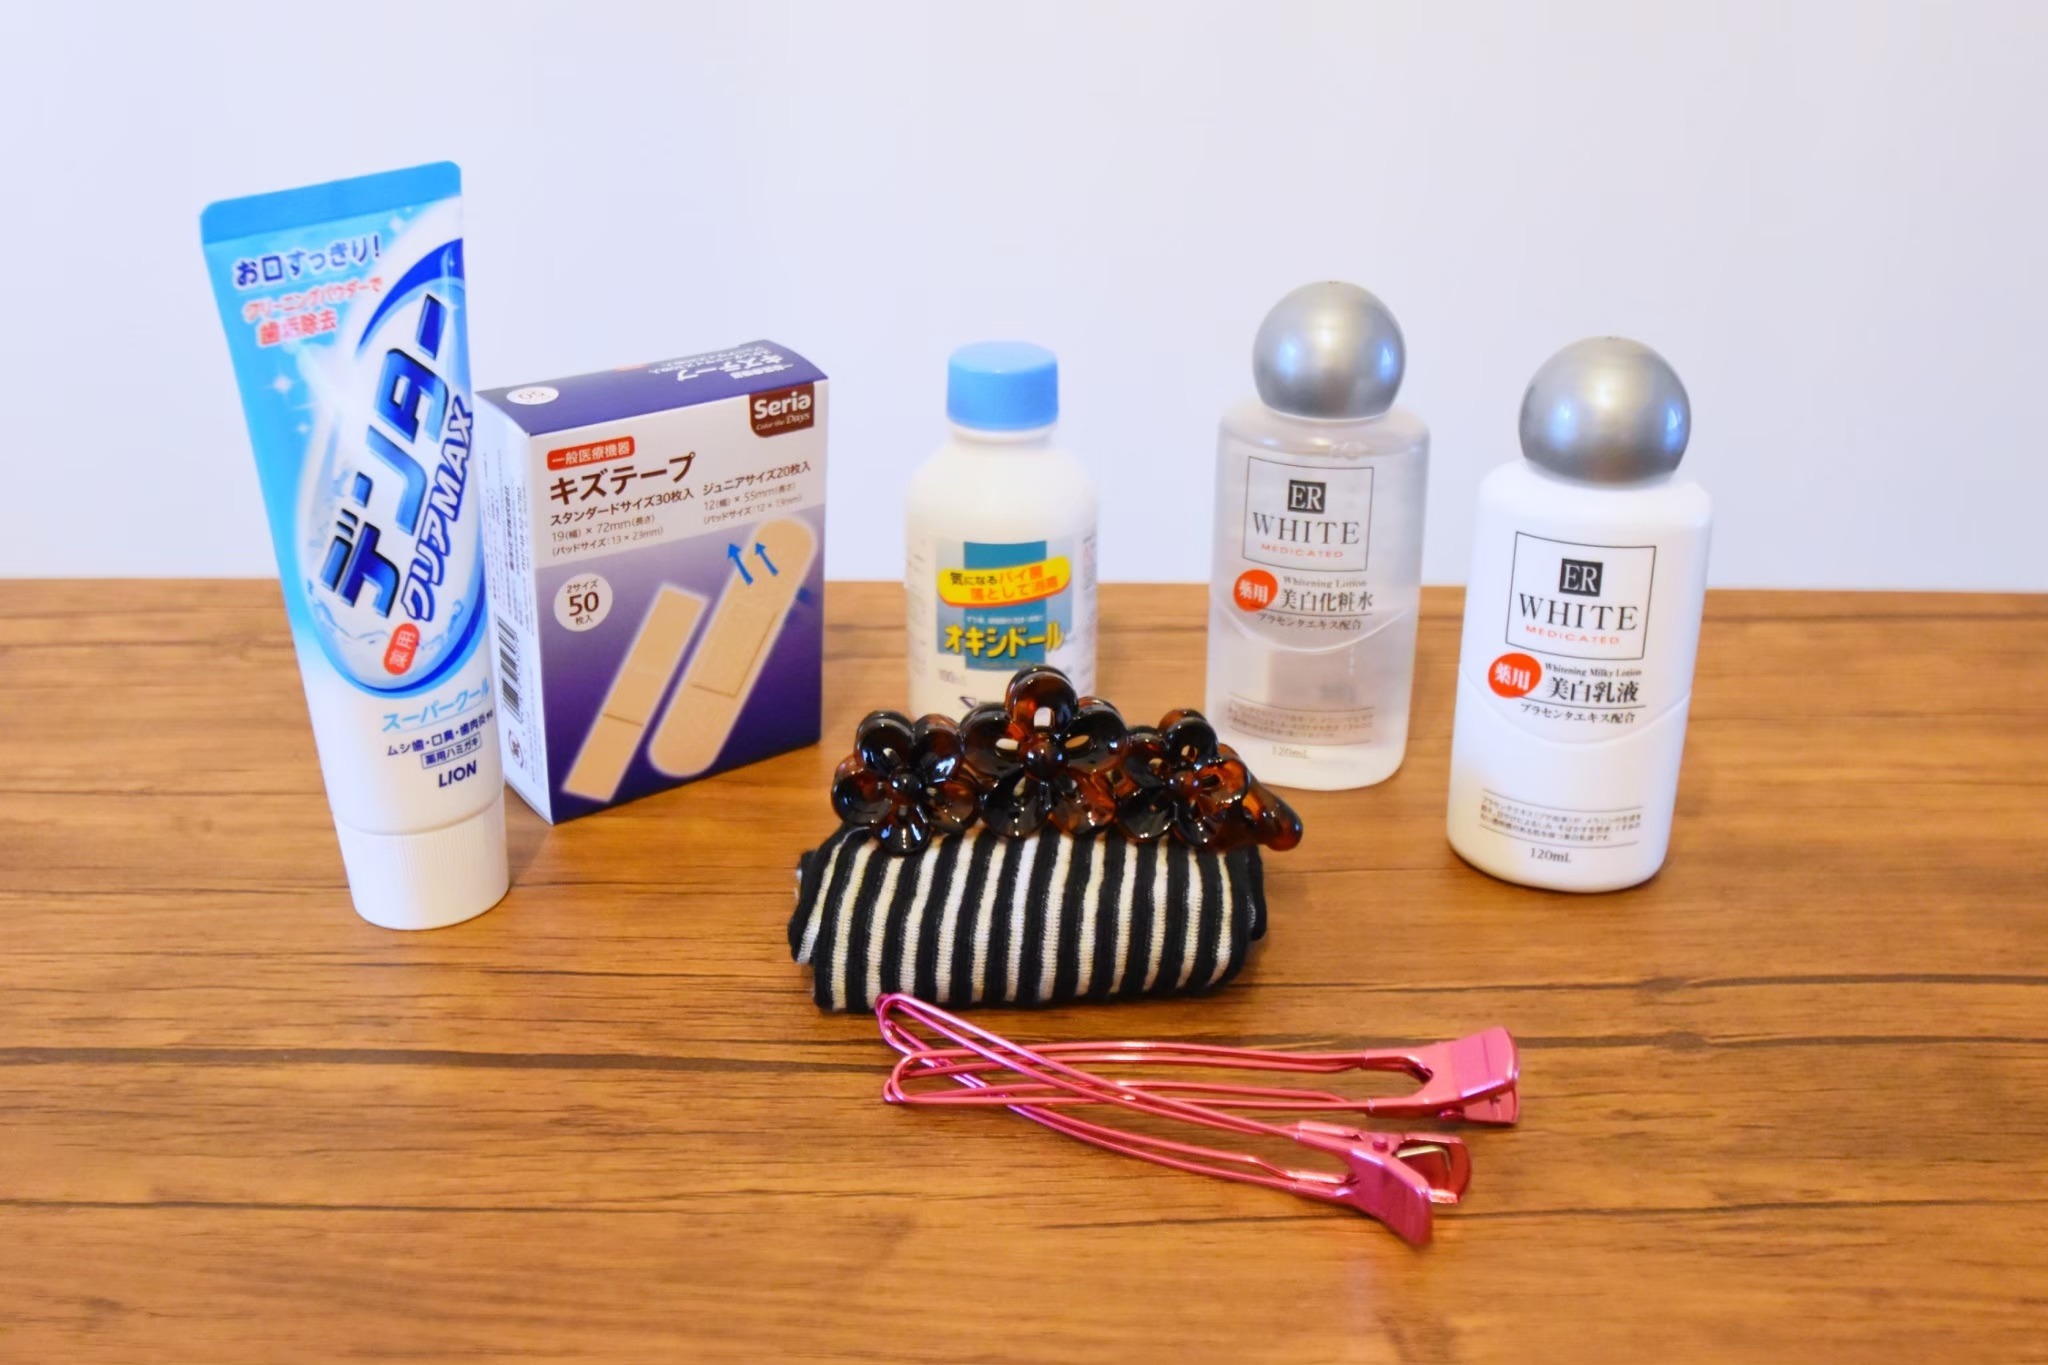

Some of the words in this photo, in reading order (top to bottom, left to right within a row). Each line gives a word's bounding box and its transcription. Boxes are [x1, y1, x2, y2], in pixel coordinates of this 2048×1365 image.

[236, 235, 380, 287] お口すっきり!
[754, 391, 811, 420] Seria
[786, 412, 810, 425] Days
[320, 293, 450, 619] デンター
[551, 441, 630, 466] 一般医療機器
[550, 452, 696, 505] キズテープ
[703, 461, 811, 496] ジュニアサイズ20枚入
[401, 395, 473, 622] クリアMAX
[550, 488, 694, 526] スタンダードサイズ30枚入
[1290, 483, 1322, 511] ER
[1252, 512, 1360, 545] WHITE
[1261, 543, 1344, 558] MEDICATED
[567, 579, 598, 593] 2サイズ
[1238, 579, 1269, 604] 薬用
[1283, 575, 1332, 589] Whitening
[1335, 578, 1367, 588] Lotion
[1562, 564, 1598, 593] ER
[569, 591, 599, 616] 50
[1281, 588, 1374, 613] 美白化粧水
[1519, 593, 1638, 631] WHITE
[1257, 612, 1363, 631] プラセンタエキス配合
[1526, 625, 1620, 645] MEDICATED
[944, 622, 1065, 657] オキシドール
[1494, 661, 1531, 691] 薬用
[1545, 662, 1587, 677] Whitening
[1590, 668, 1613, 679] Milky
[1615, 668, 1642, 677] Lotion
[1548, 676, 1640, 704] 美白乳液
[382, 677, 490, 732] スーパークール
[1521, 702, 1636, 725] プラセンタエキス配合
[424, 737, 479, 765] 薬用ハミガキ
[438, 760, 477, 787] LION
[1530, 847, 1572, 864] 120mL
